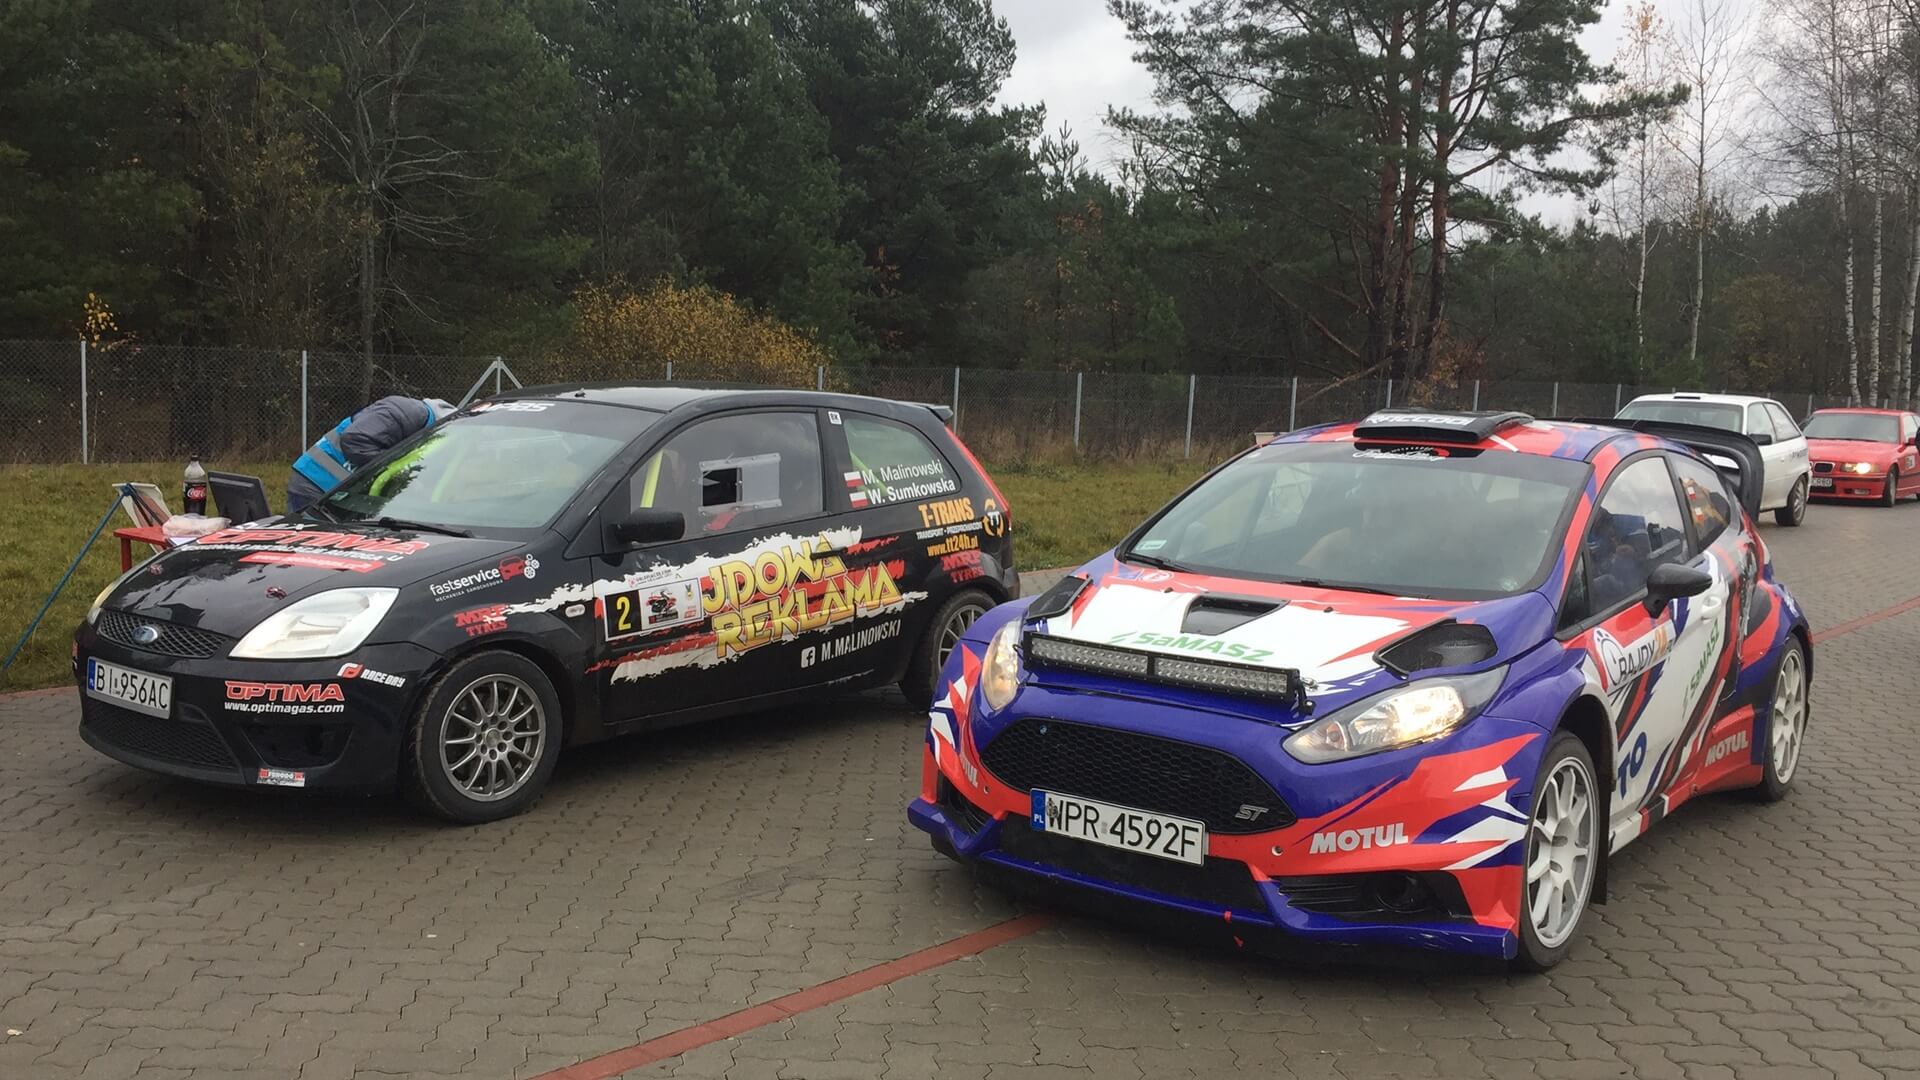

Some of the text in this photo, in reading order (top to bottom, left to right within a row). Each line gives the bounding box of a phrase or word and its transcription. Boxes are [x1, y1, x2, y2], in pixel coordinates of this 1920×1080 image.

[862, 459, 944, 485] M. Malinowski
[868, 478, 956, 505] W. Sumkowska
[918, 497, 975, 528] T-TRANS
[429, 568, 501, 596] fastservice
[616, 596, 632, 631] 2
[712, 561, 905, 659] REKLAMA
[225, 681, 345, 702] OPTIMA
[225, 701, 345, 715] www.optimagas.com
[1704, 730, 1748, 768] MOTUL
[1034, 813, 1044, 824] PL
[1235, 804, 1269, 822] ST
[1109, 812, 1199, 857] 4592F
[1309, 822, 1409, 855] MOTUL
